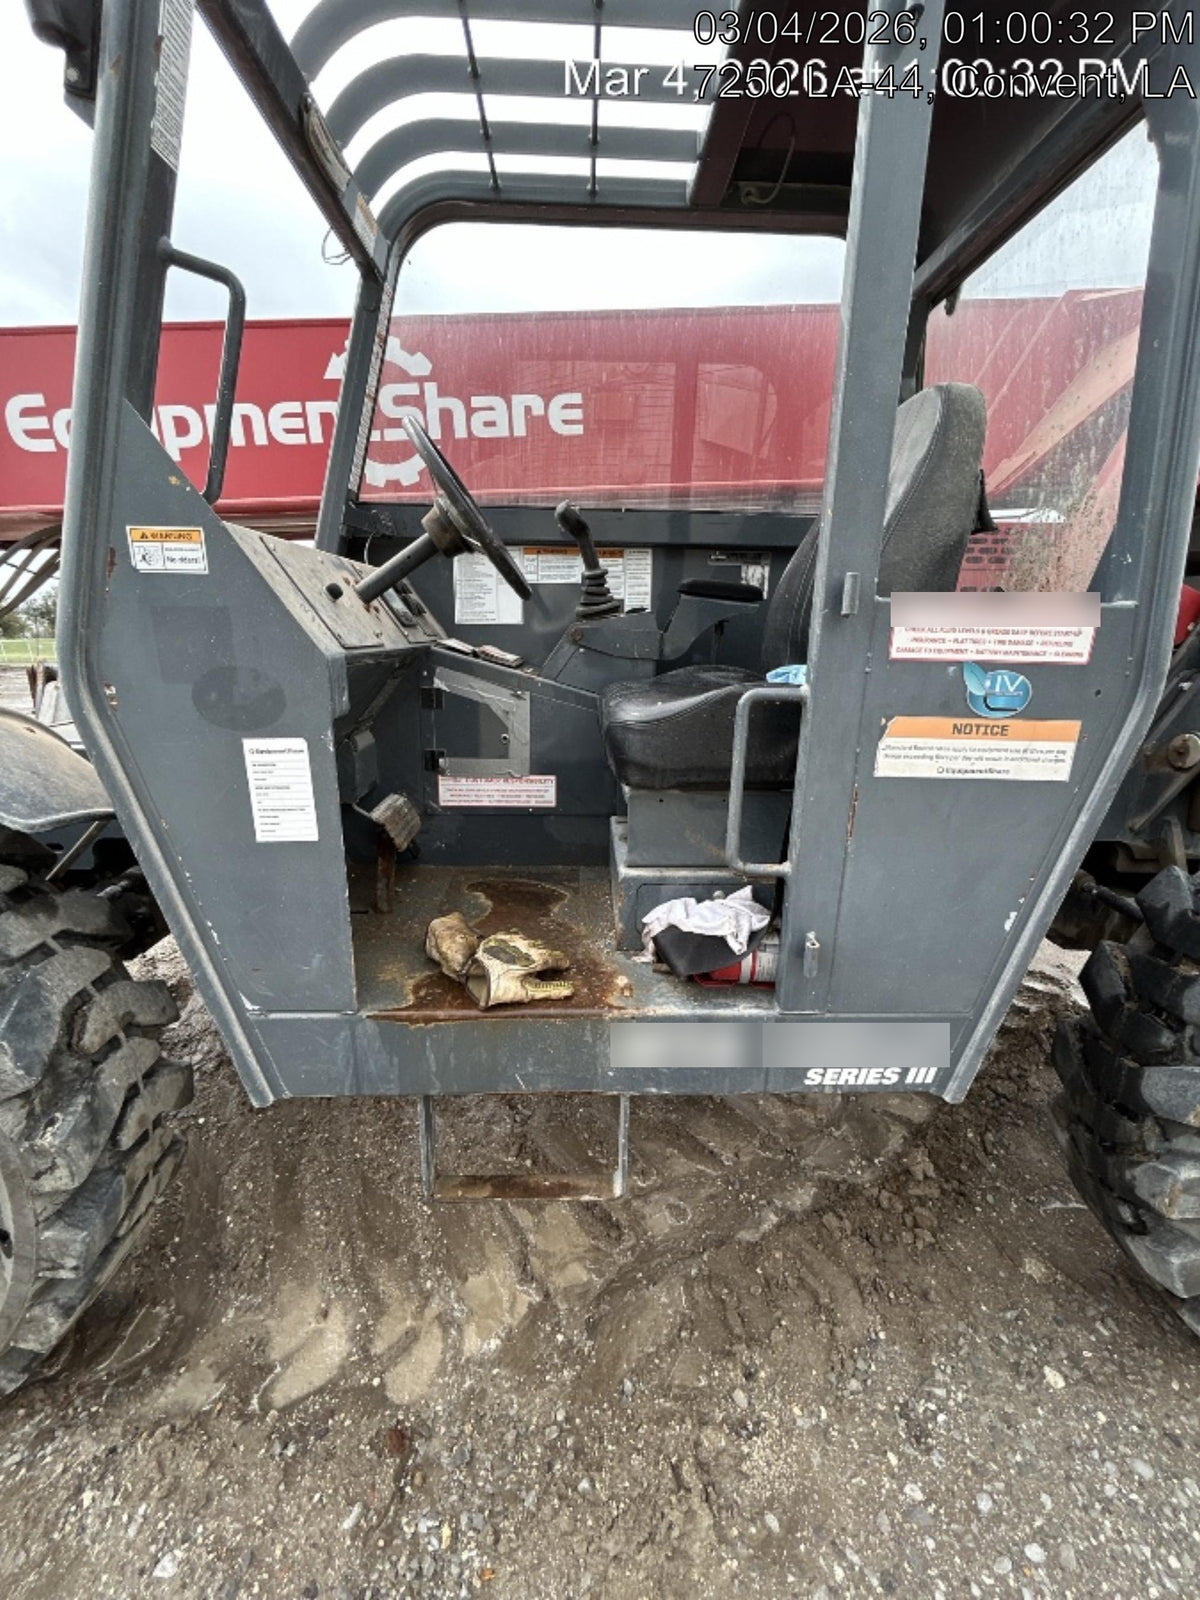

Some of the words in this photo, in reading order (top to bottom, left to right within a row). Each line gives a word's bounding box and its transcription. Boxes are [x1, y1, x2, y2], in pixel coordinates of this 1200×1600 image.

[951, 722, 1010, 737] NOTICE
[804, 1066, 901, 1086] SERIES
[905, 1066, 938, 1085] III
